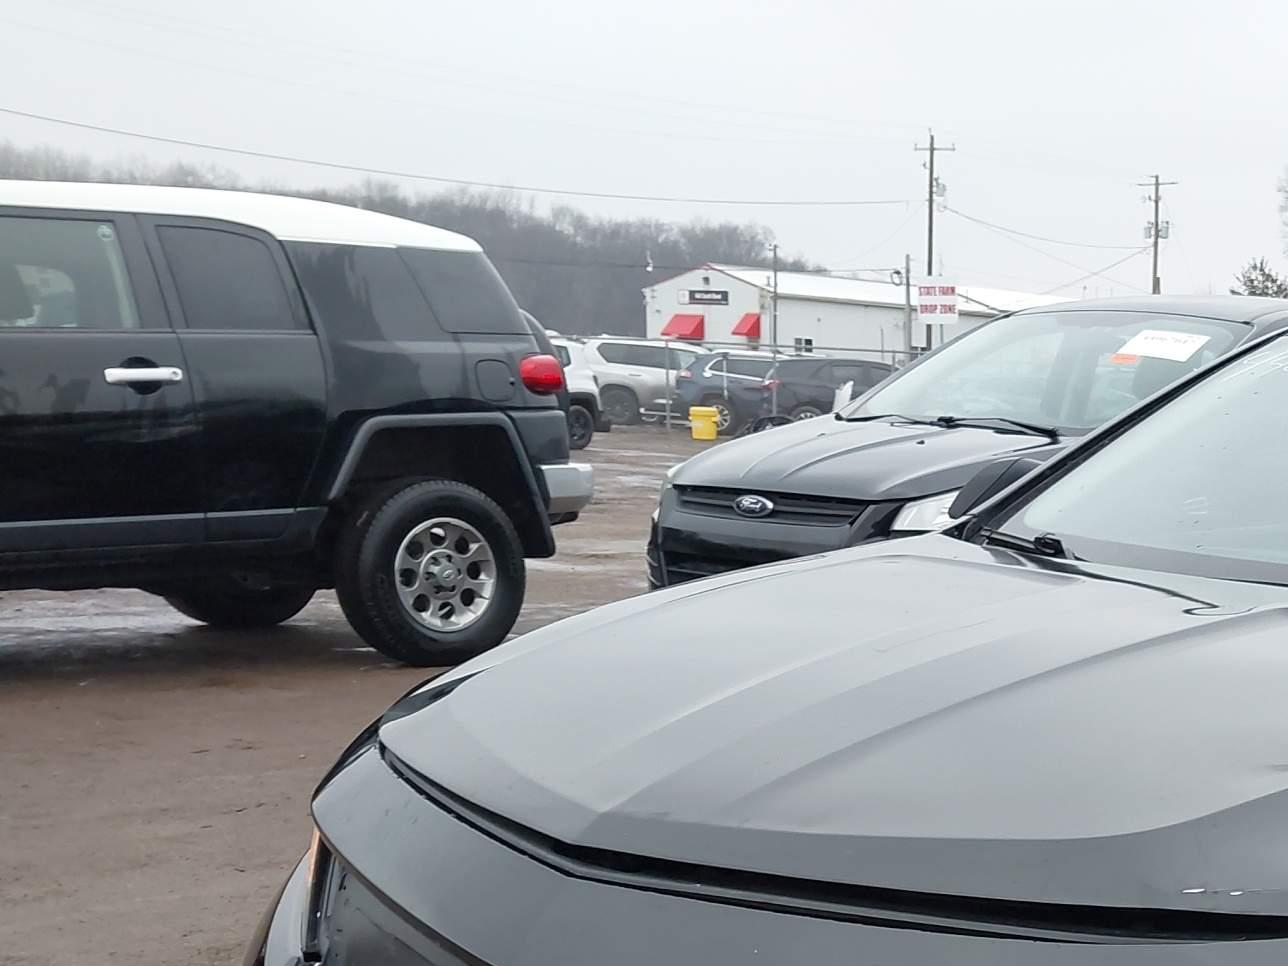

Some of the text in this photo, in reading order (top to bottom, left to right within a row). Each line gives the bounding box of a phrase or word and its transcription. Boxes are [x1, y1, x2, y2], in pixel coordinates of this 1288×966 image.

[918, 286, 956, 296] STATE FARM
[919, 304, 957, 314] DROP ZONE
